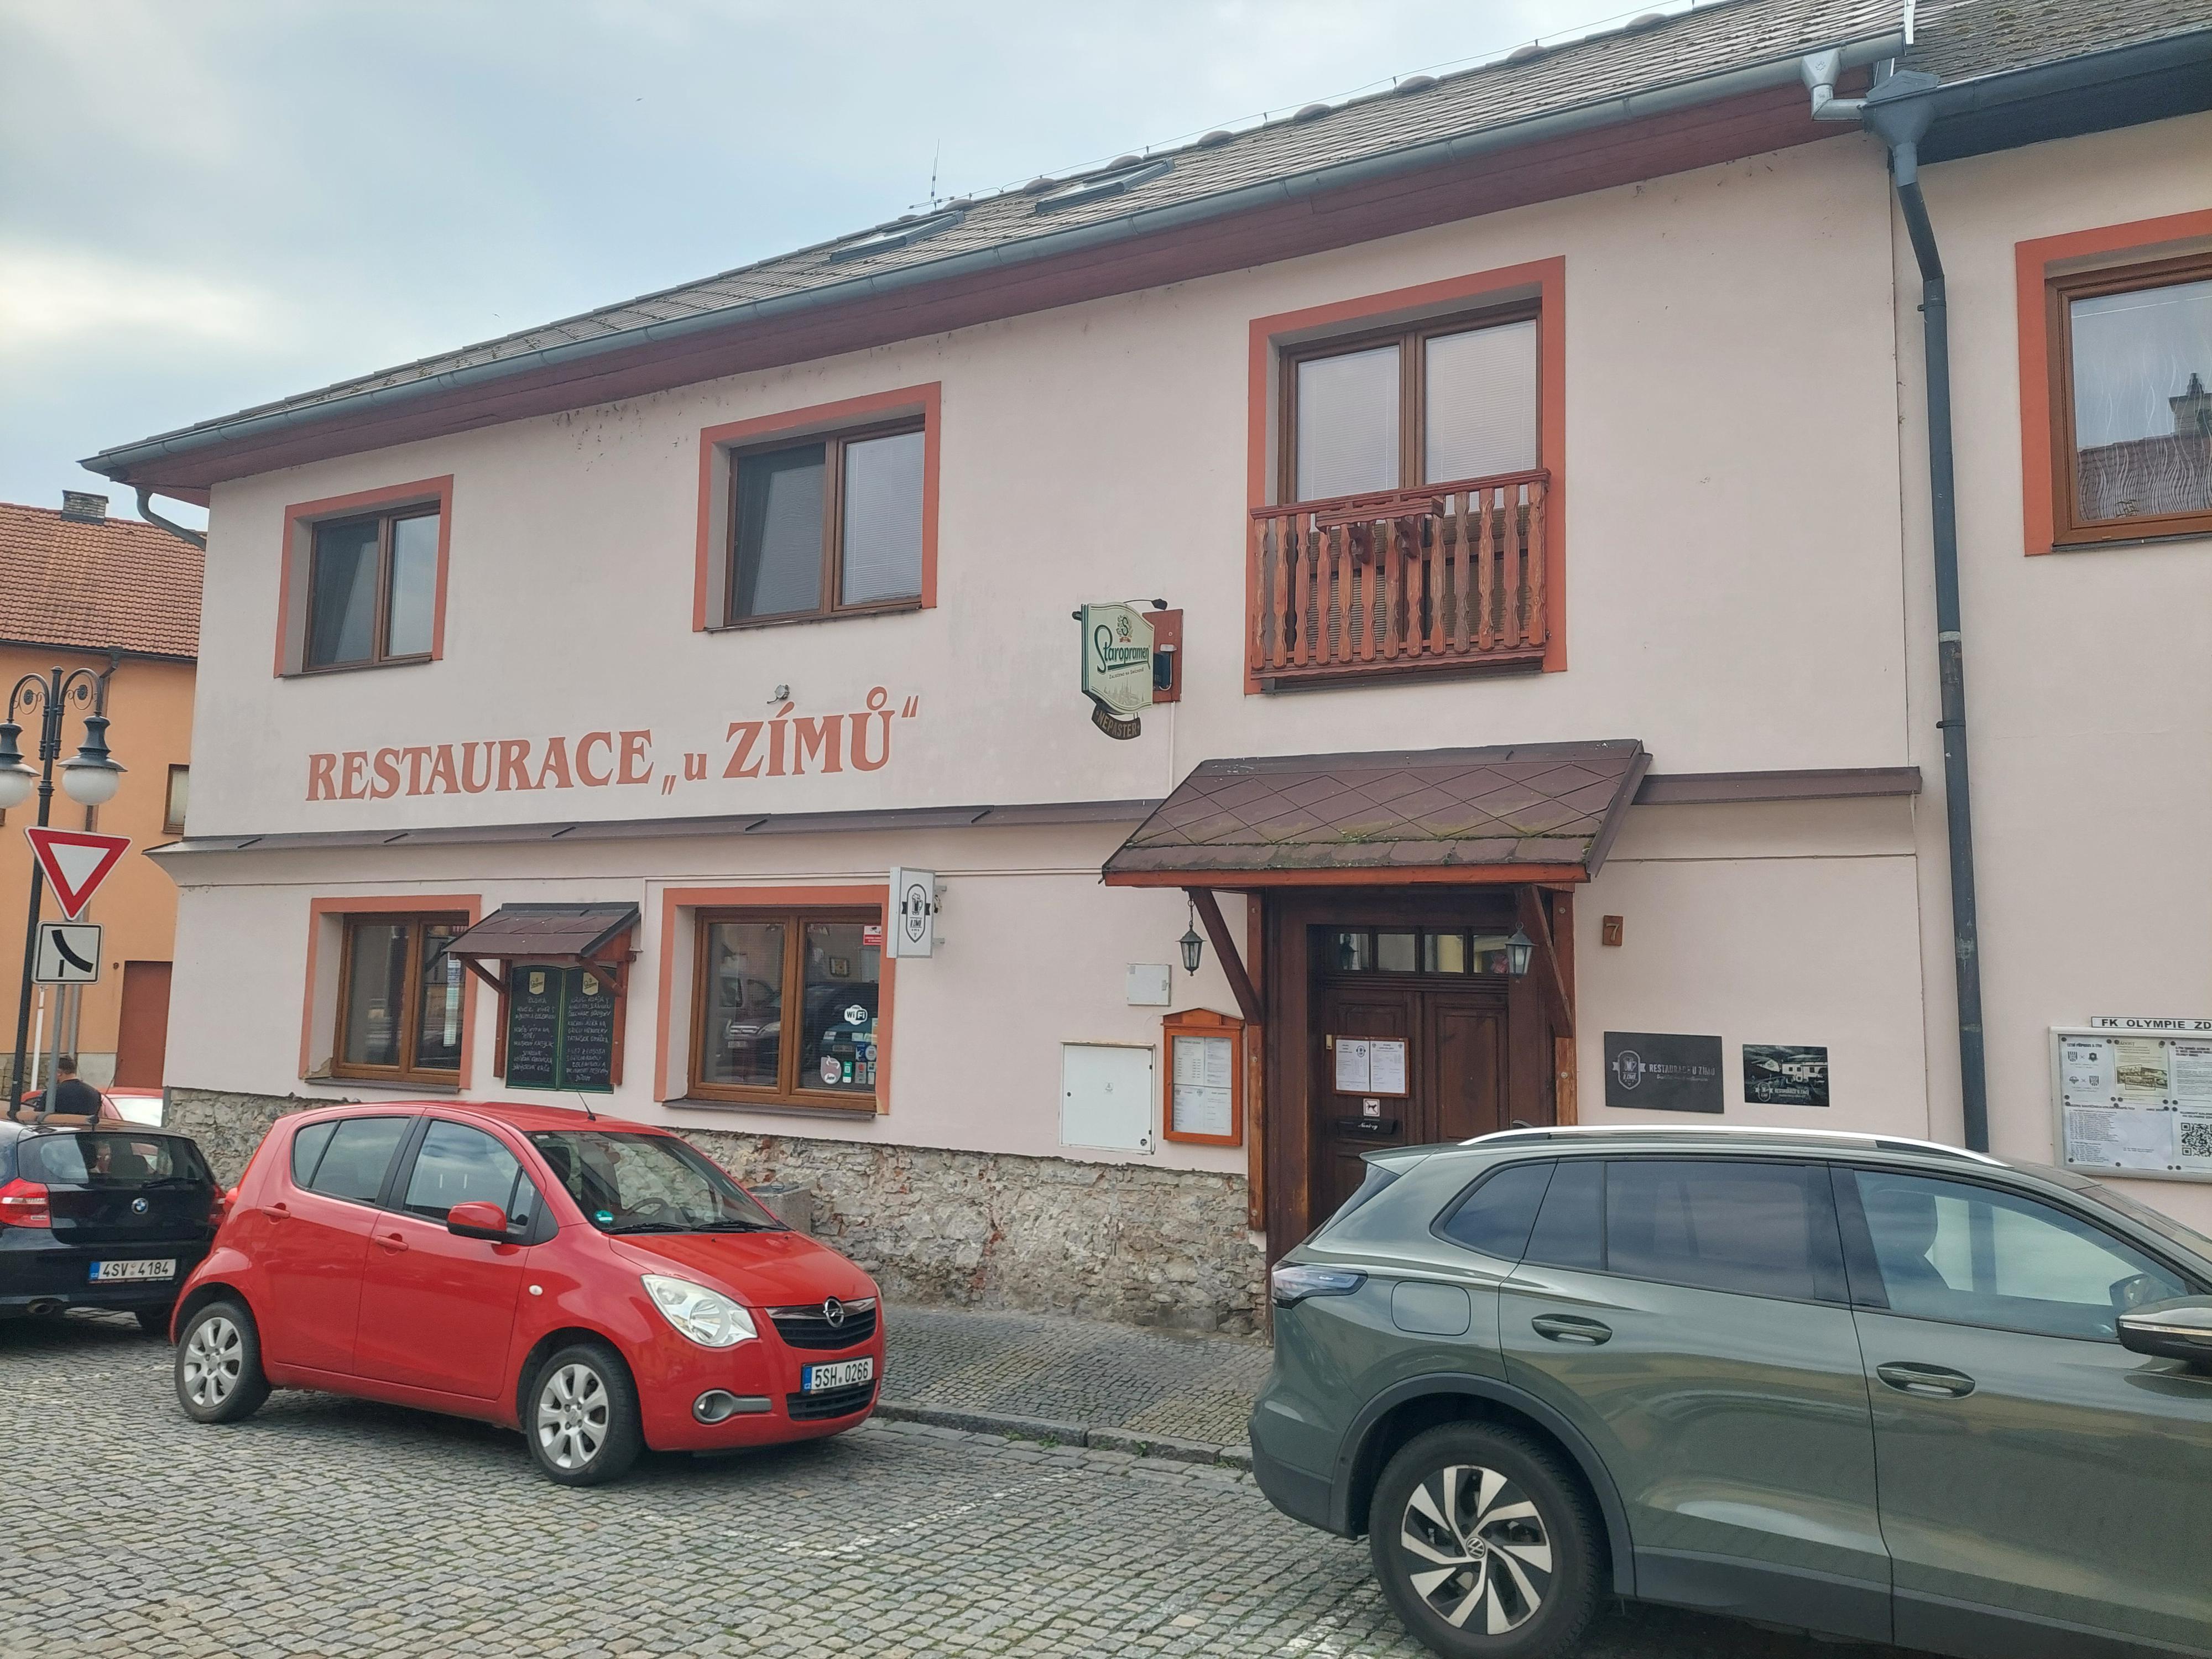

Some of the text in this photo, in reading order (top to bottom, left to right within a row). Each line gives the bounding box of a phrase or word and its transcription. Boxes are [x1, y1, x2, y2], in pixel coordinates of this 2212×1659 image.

[1094, 624, 1150, 673] Staropramen
[1097, 711, 1137, 737] NEPASTER
[305, 729, 654, 801] RESTAURACE
[1606, 923, 1620, 941] 7
[2126, 1020, 2185, 1029] OLYMPIE
[103, 1261, 169, 1277] 4SV 4184
[815, 1361, 869, 1387] 5SH 0266
